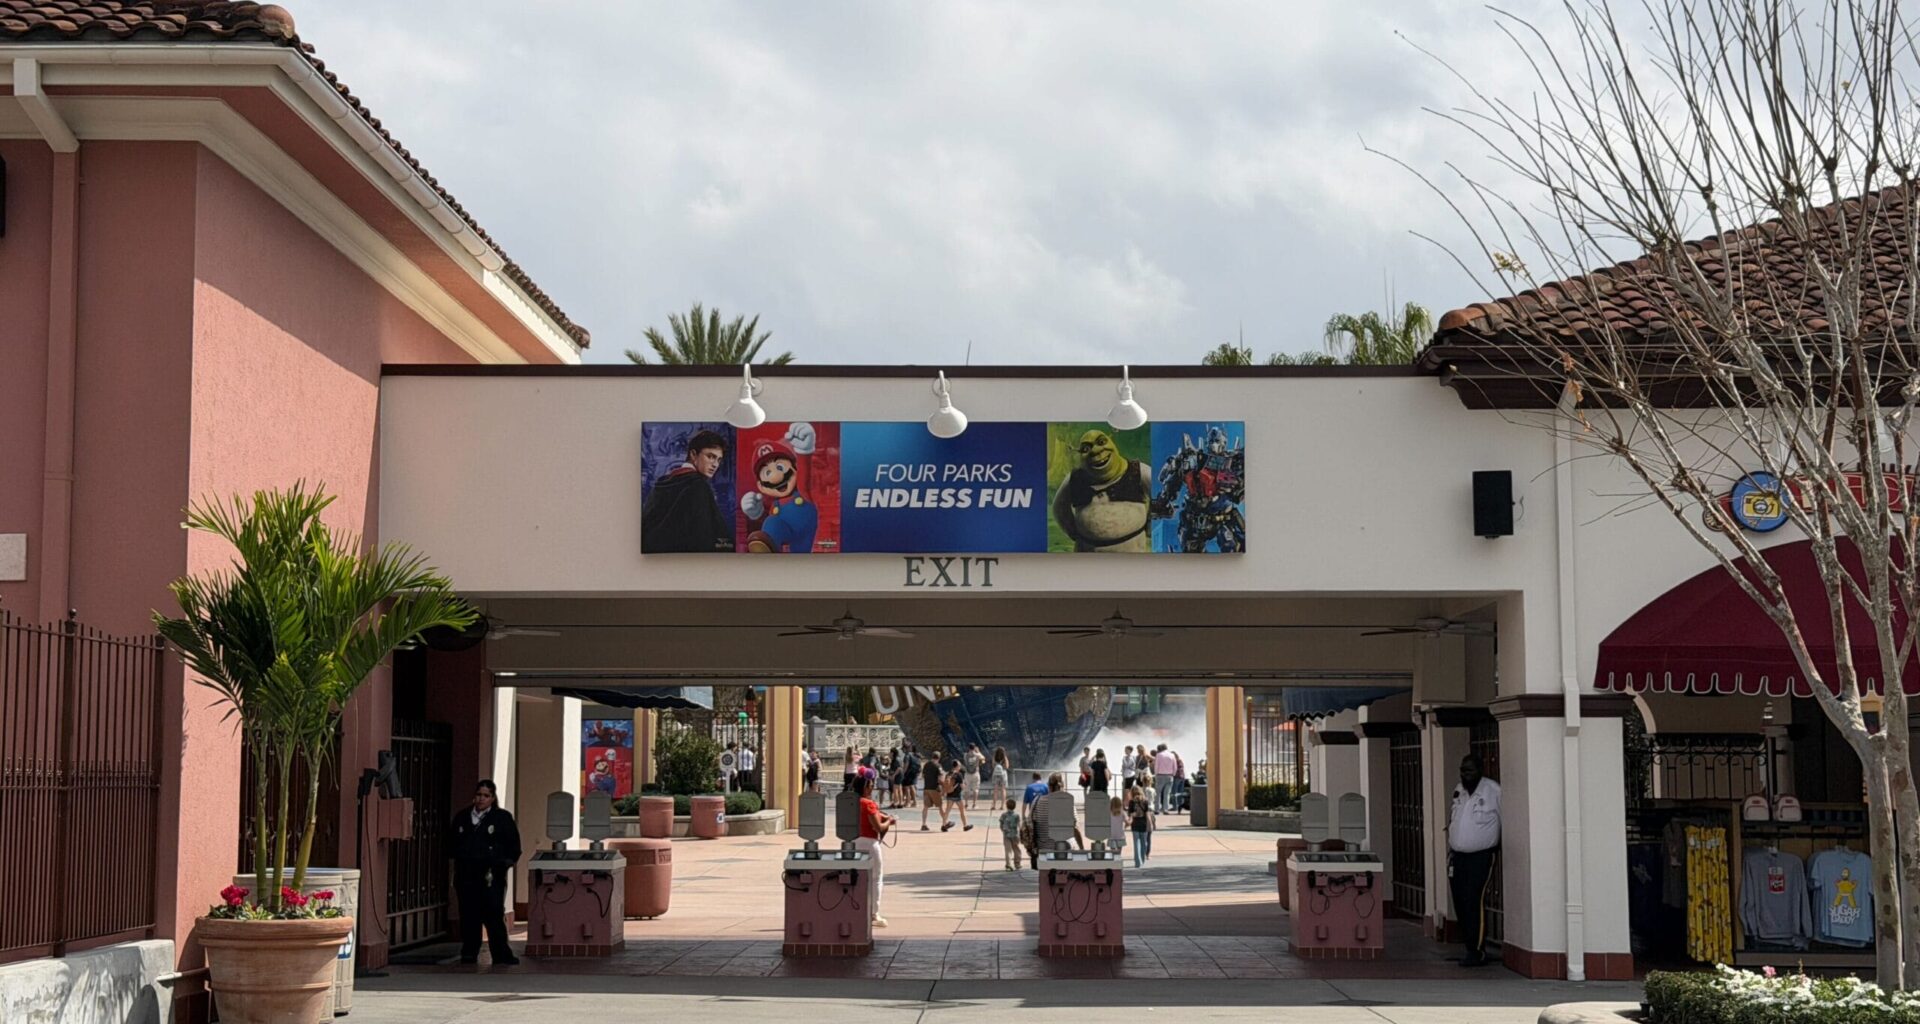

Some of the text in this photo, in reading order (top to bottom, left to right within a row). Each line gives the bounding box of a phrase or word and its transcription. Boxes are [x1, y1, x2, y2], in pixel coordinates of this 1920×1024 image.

[875, 463, 1013, 482] FOUR PARKS
[855, 488, 1033, 508] ENDLESS FUN
[903, 556, 999, 587] EXIT
[1829, 904, 1861, 918] SUGAR
